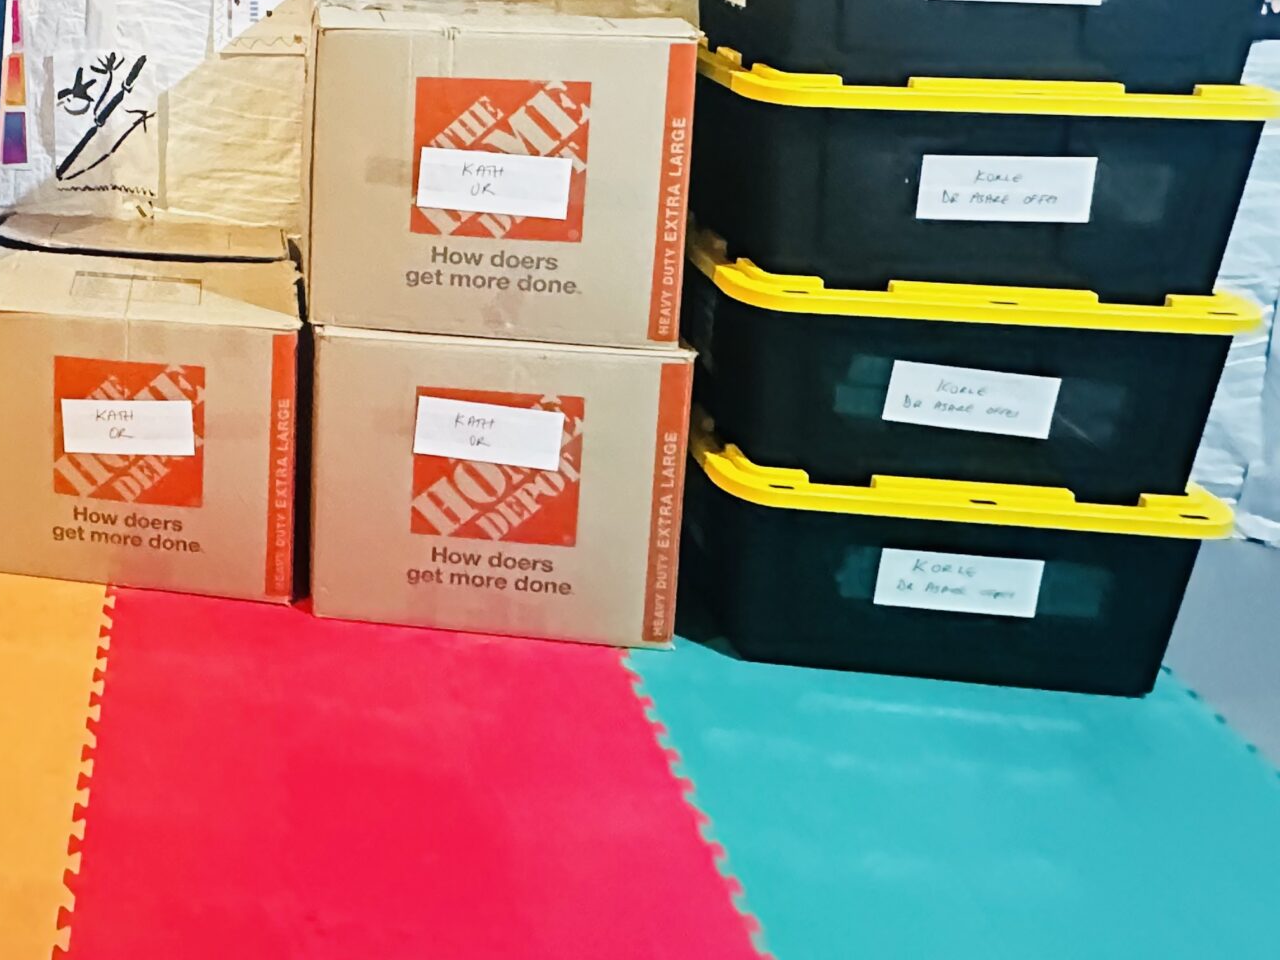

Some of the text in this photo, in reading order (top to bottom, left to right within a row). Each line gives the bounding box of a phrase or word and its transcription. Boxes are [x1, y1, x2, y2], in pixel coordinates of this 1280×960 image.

[461, 161, 504, 178] KATH
[973, 170, 1024, 183] KORLE
[658, 116, 686, 335] HEAVY DUTY EXTRA LARGE
[430, 246, 558, 270] How doers
[406, 269, 444, 287] get
[449, 272, 510, 290] more
[95, 408, 134, 421] KATH
[276, 399, 291, 452] LARGE
[454, 413, 496, 430] KATH
[109, 427, 134, 439] OR
[660, 432, 678, 489] LARGE
[275, 457, 288, 509] EXTRA
[73, 505, 183, 532] How doers
[657, 494, 673, 549] EXTRA
[52, 525, 85, 541] get
[90, 528, 143, 547] more
[431, 546, 554, 572] How doers
[912, 558, 976, 577] KORLE
[407, 568, 444, 585] get
[450, 571, 508, 590] more
[655, 555, 669, 590] DUTY
